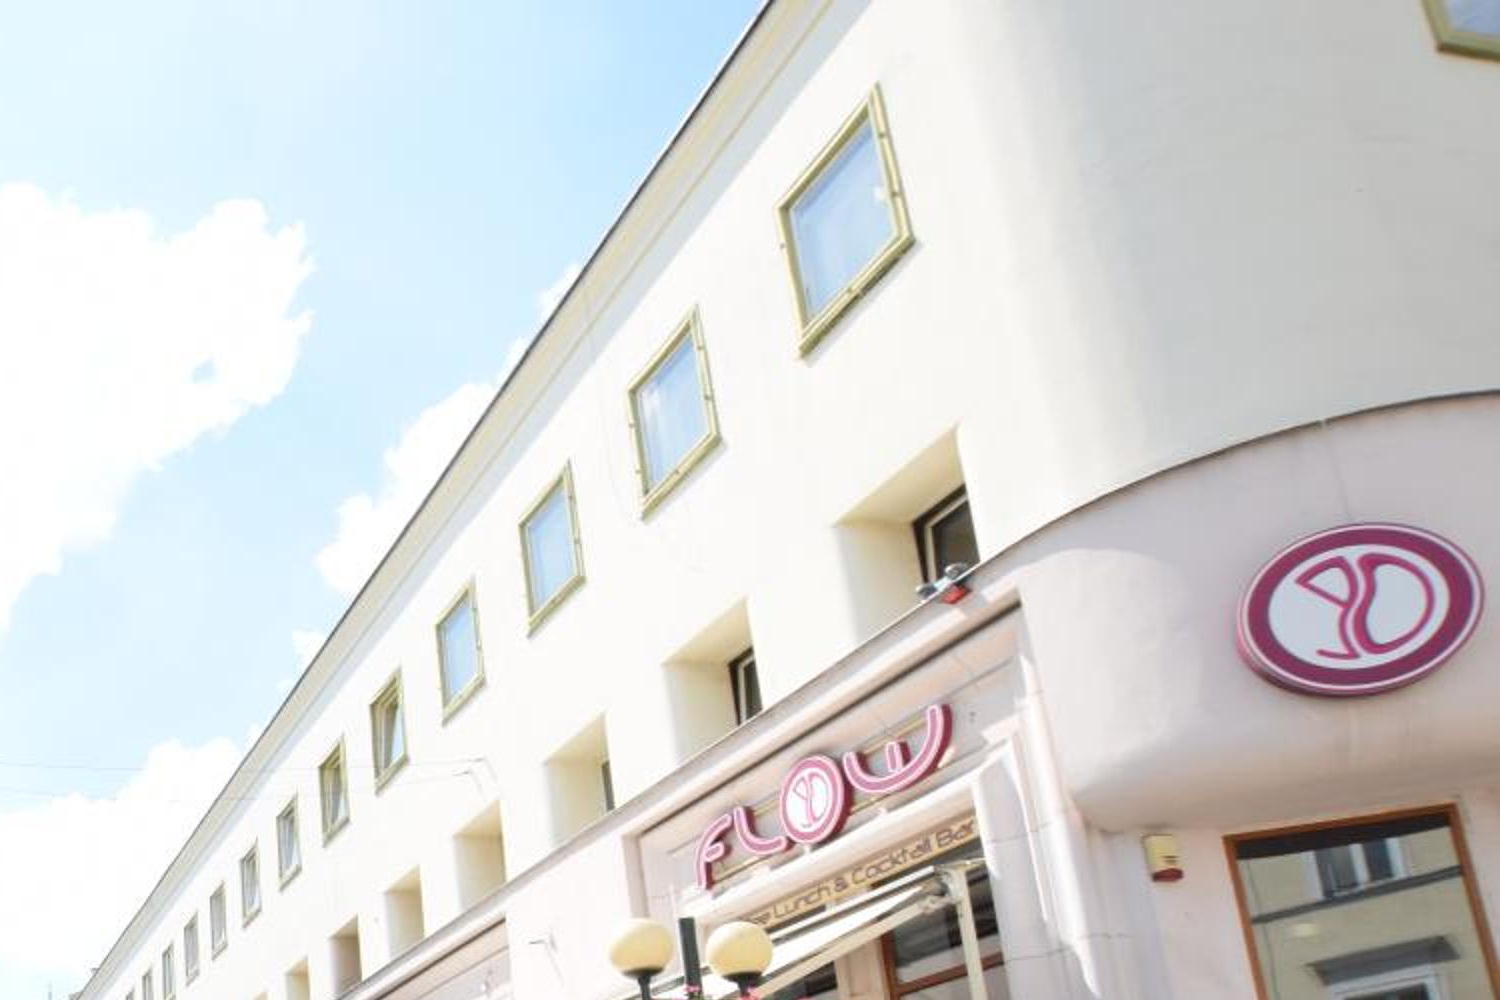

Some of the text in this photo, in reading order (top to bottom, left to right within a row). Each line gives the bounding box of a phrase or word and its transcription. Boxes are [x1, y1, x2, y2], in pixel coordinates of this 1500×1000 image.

[693, 704, 953, 890] FLOW
[773, 884, 830, 918] Lunch
[834, 877, 849, 893] &
[937, 819, 975, 849] Bar
